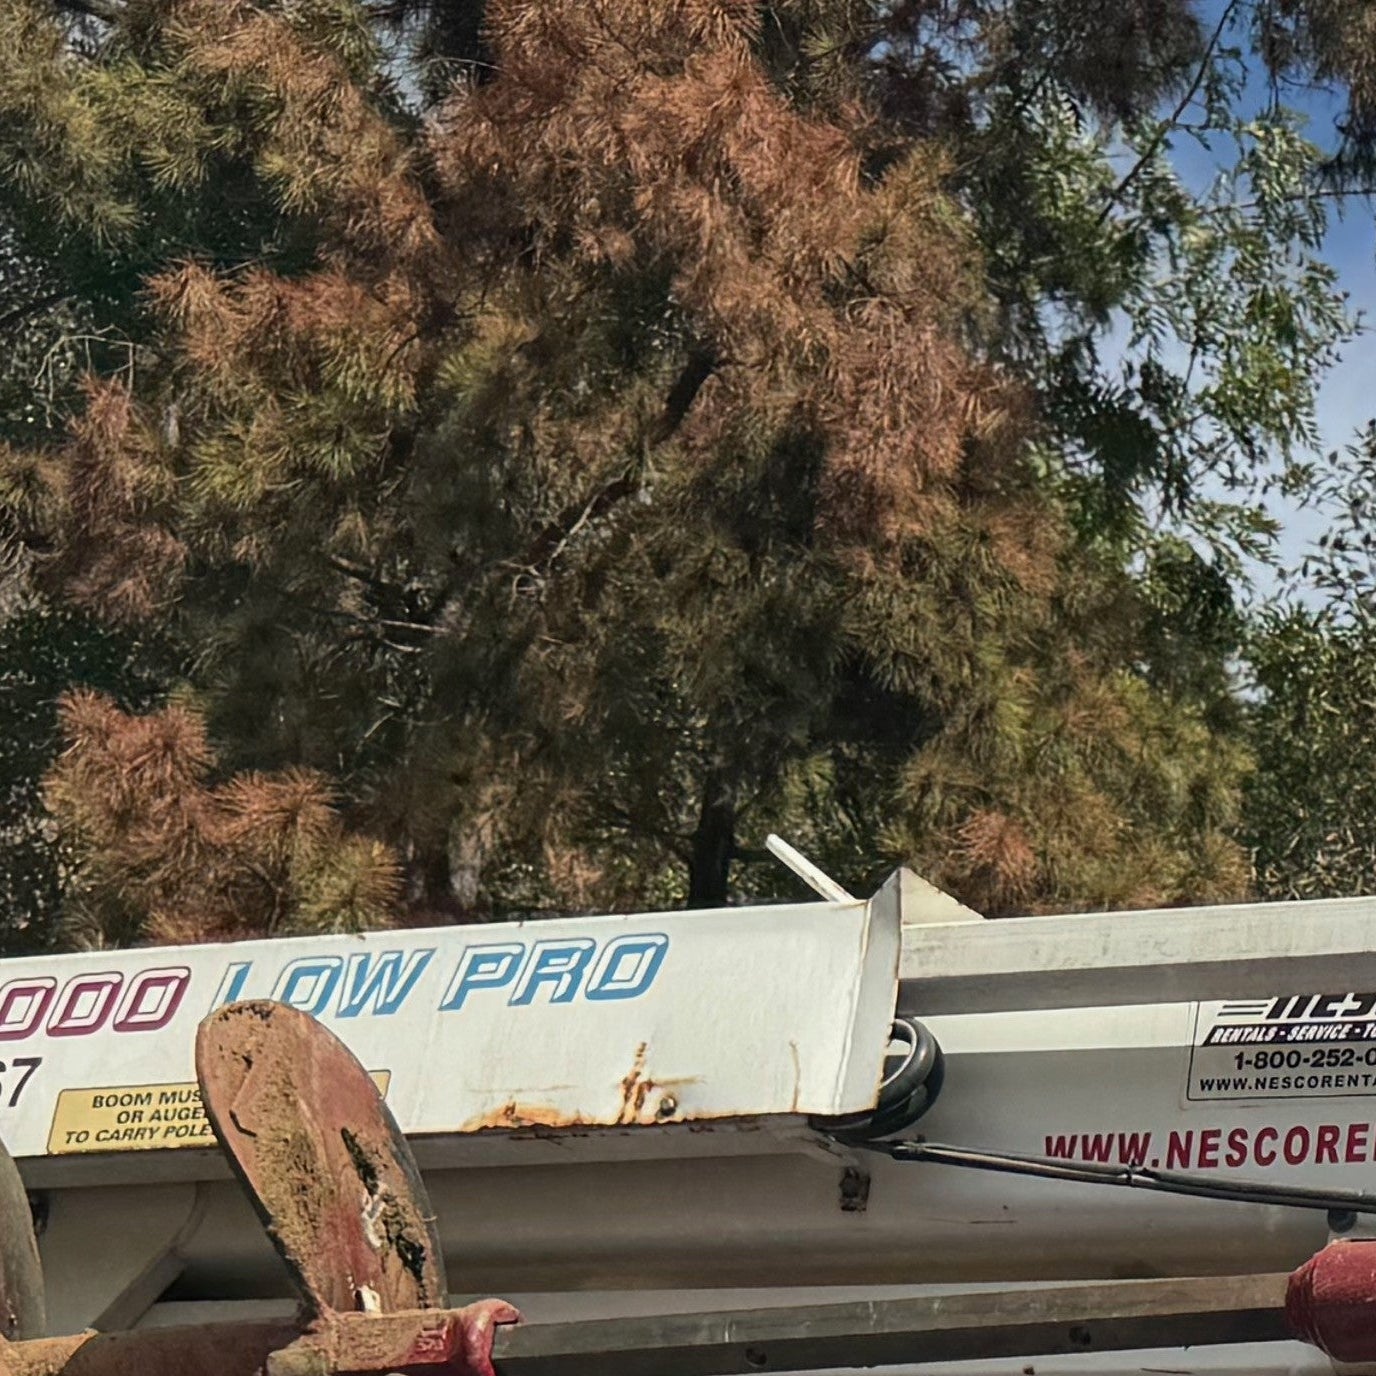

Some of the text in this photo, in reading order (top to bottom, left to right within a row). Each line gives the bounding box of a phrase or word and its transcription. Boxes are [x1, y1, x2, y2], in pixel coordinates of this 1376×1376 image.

[438, 933, 669, 1011] PRO
[1209, 1026, 1279, 1044] RENTALS
[1286, 1023, 1354, 1042] SERVICE
[0, 1056, 43, 1108] 7
[92, 1089, 202, 1109] BOOM MUS
[116, 1106, 209, 1125] OR AUGE
[64, 1123, 213, 1145] TO CARRY POLE
